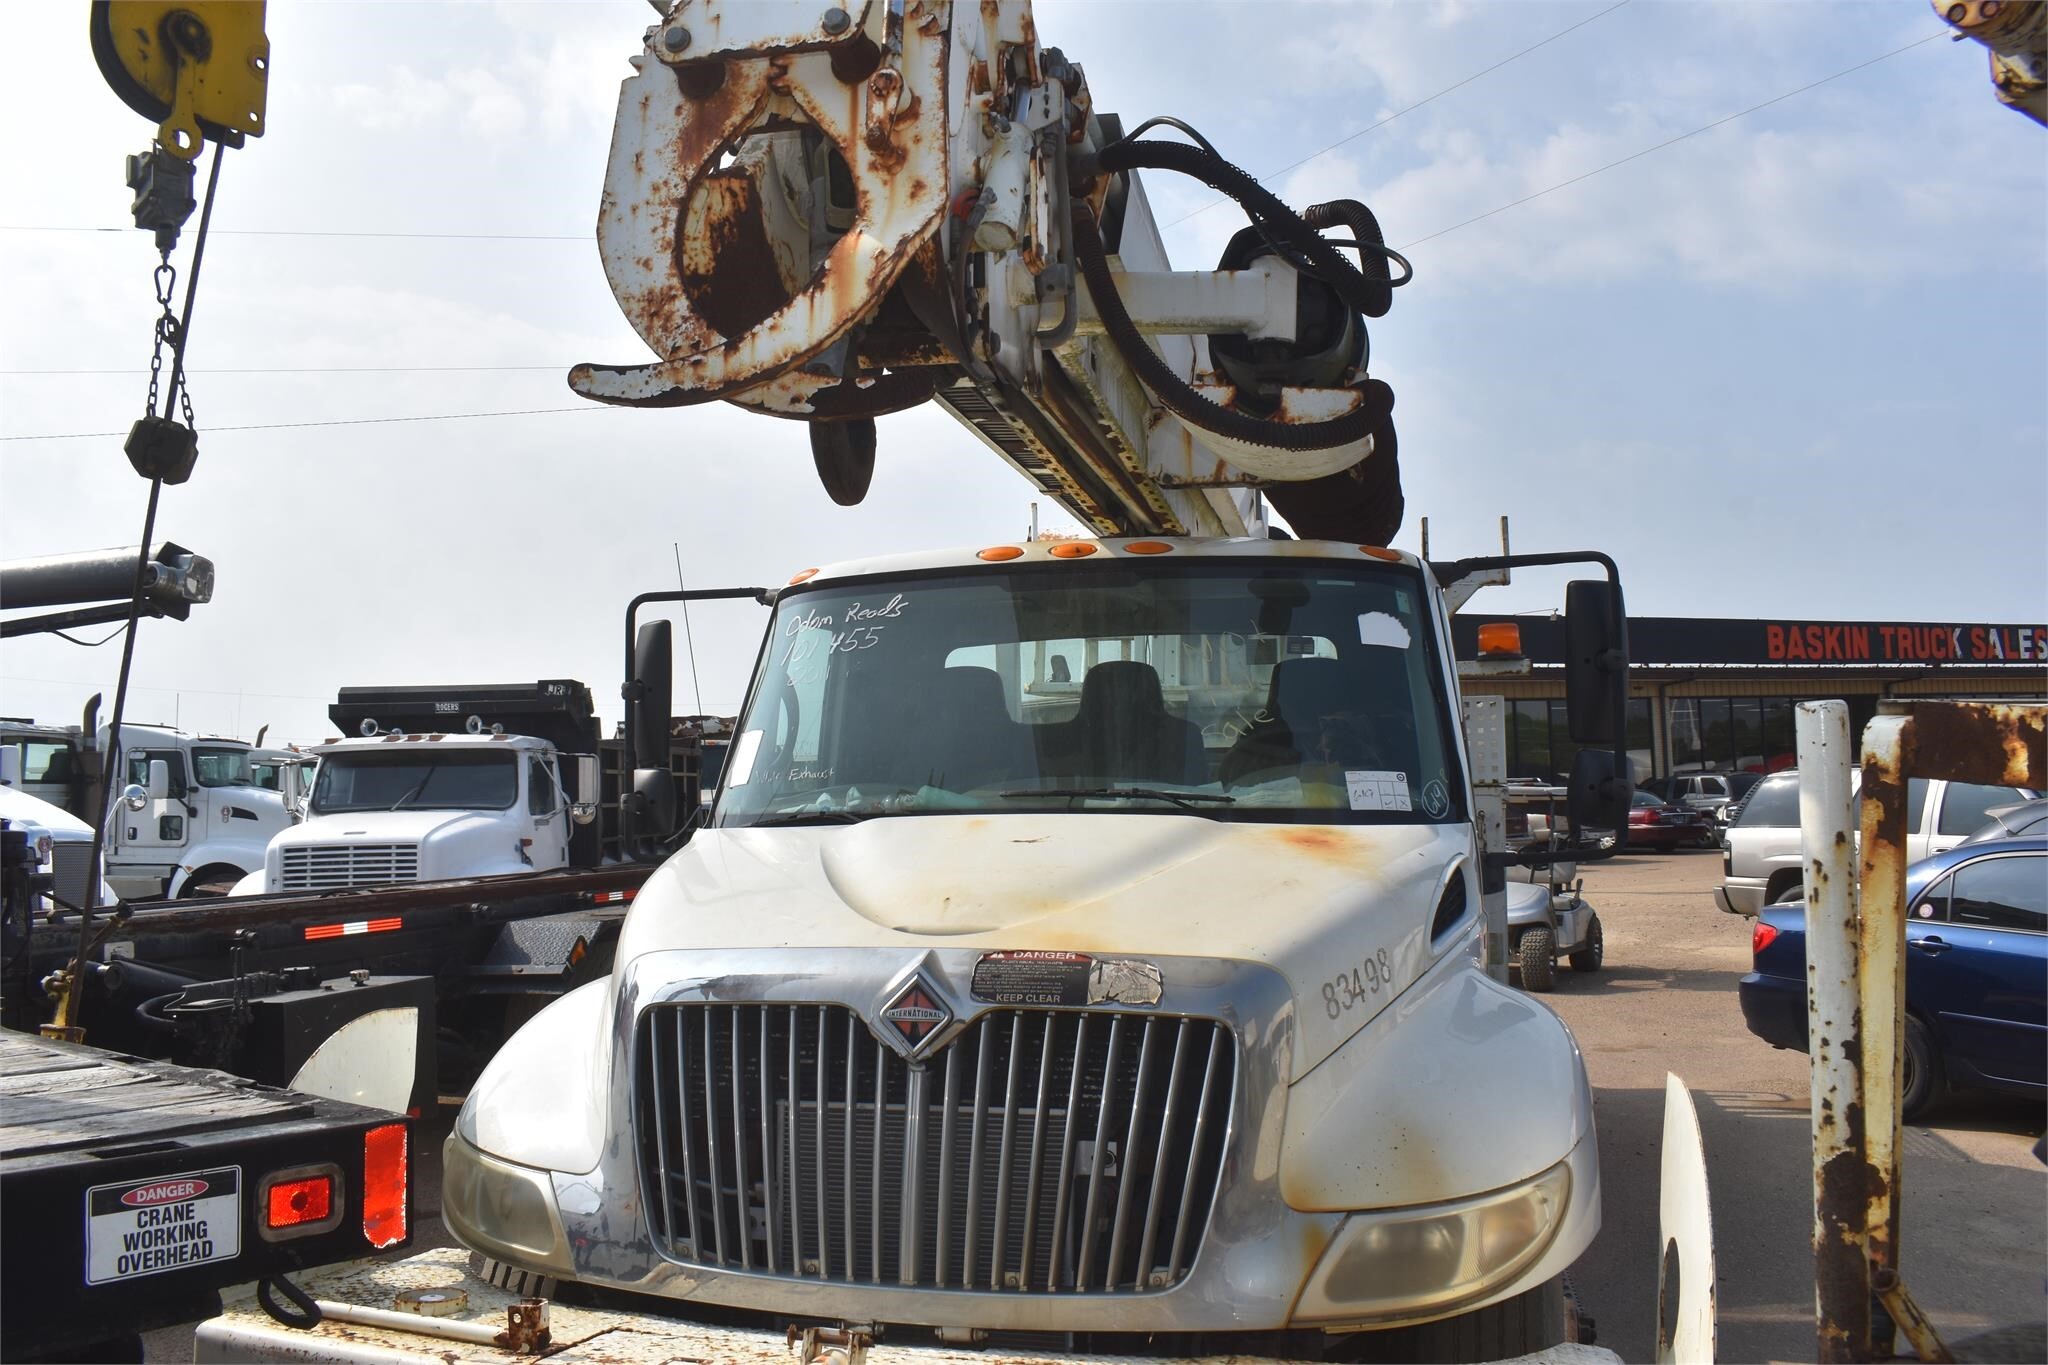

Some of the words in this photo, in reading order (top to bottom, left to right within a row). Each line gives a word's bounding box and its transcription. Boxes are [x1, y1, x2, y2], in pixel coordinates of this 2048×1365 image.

[1766, 625, 1870, 659] BASKIN
[1880, 627, 1962, 659] TRUCK
[1971, 628, 2048, 660] SALES
[1013, 951, 1077, 960] DANGER
[1322, 947, 1392, 1020] 83498
[996, 993, 1023, 1003] KEEP
[1025, 993, 1061, 1003] CLEAR
[888, 1008, 942, 1019] INTERNATIONAL
[136, 1182, 195, 1203] DANGER
[137, 1203, 195, 1229] CRANE
[123, 1220, 208, 1252] WORKING
[117, 1240, 214, 1275] OVERHEAD
